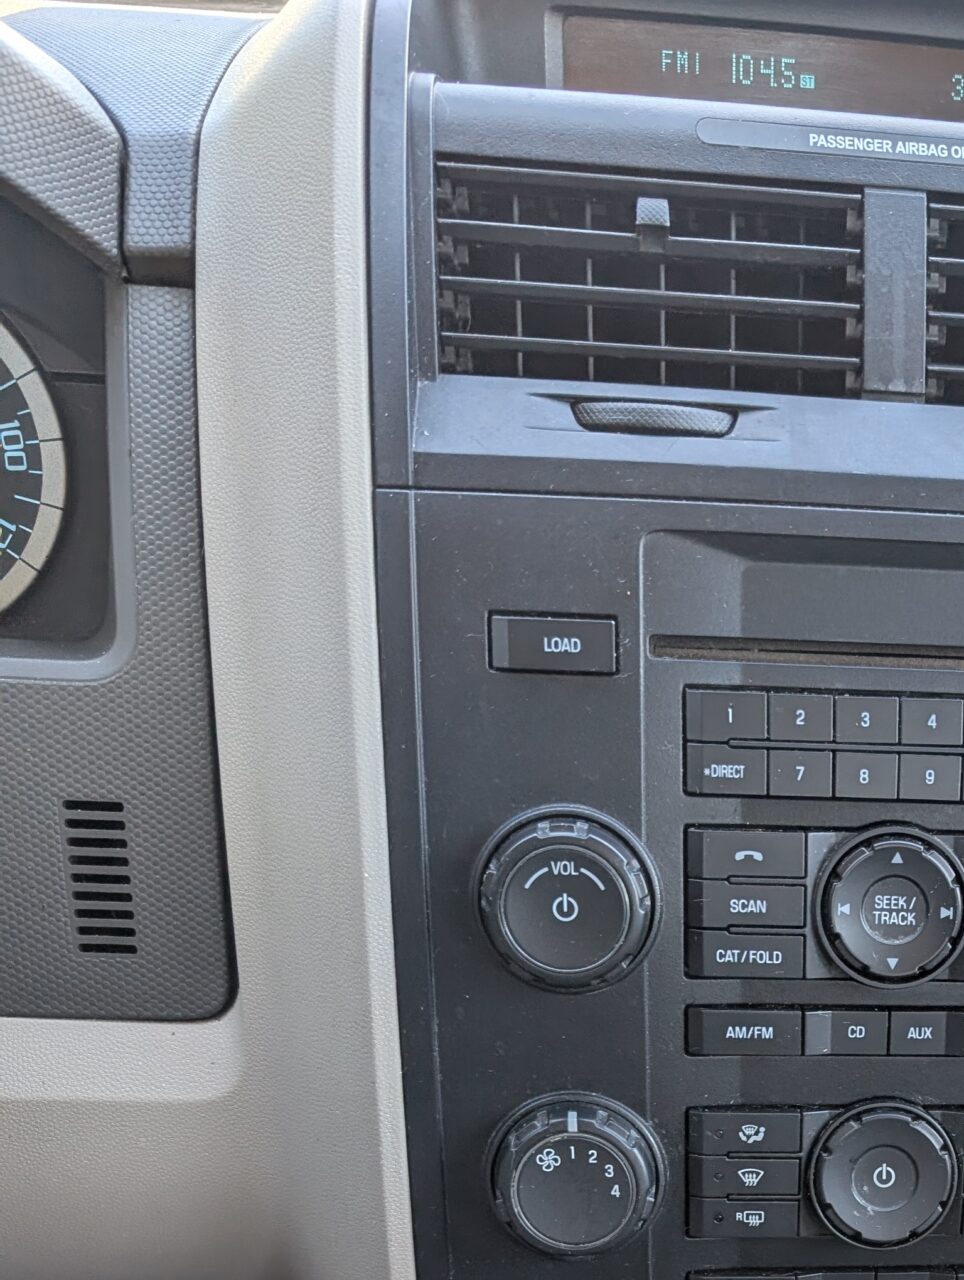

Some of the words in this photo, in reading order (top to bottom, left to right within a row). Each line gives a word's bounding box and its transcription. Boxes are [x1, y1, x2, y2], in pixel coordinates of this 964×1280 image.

[808, 133, 893, 153] PASSENGER
[895, 141, 949, 158] AIRBAG
[543, 636, 581, 653] LOAD
[727, 708, 733, 724] 1
[795, 709, 805, 725] 2
[860, 711, 870, 728] 3
[927, 714, 937, 729] 4
[795, 765, 805, 781] 7
[859, 768, 869, 784] 8
[925, 769, 935, 785] 9
[550, 860, 580, 876] VOL
[729, 898, 767, 914] SCAN
[872, 911, 916, 926] TRACK
[716, 949, 782, 964] CAT/FOLD
[725, 1026, 774, 1039] AM/FM
[847, 1025, 866, 1038] CD
[907, 1026, 933, 1040] AUX
[569, 1145, 575, 1160] 1
[588, 1149, 598, 1164] 2
[604, 1164, 614, 1178] 3
[610, 1184, 621, 1198] 4
[735, 1212, 743, 1222] R
